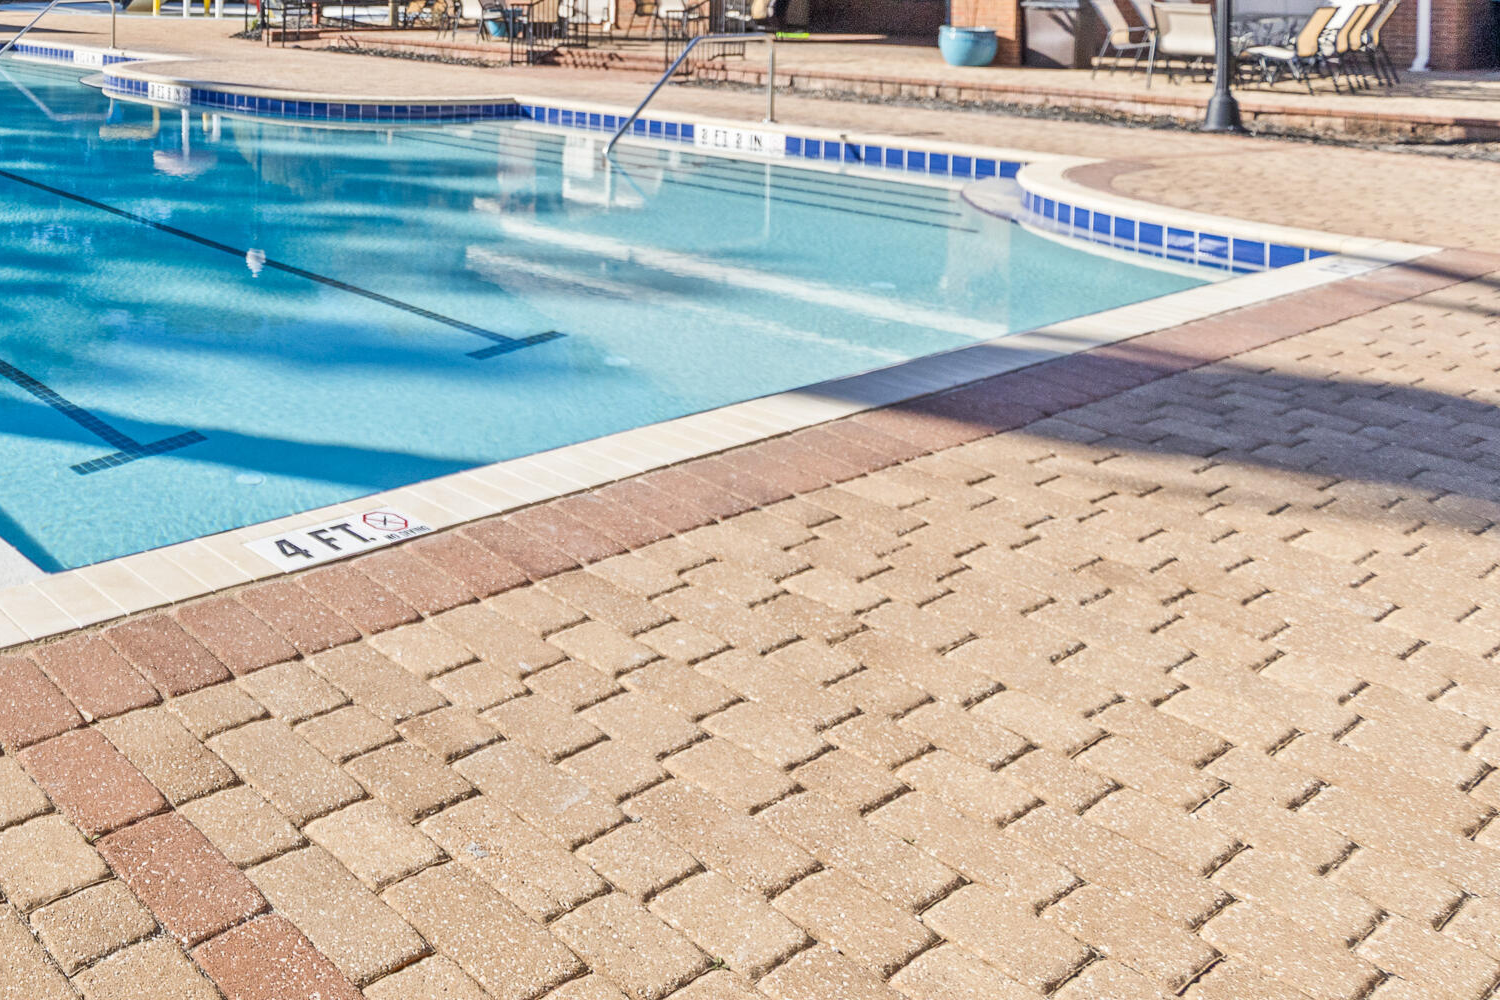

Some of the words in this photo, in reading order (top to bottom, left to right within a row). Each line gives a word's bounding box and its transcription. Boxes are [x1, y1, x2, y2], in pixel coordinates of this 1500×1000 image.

[274, 539, 314, 558] 4
[307, 523, 377, 550] FT.
[399, 525, 431, 537] DIVING
